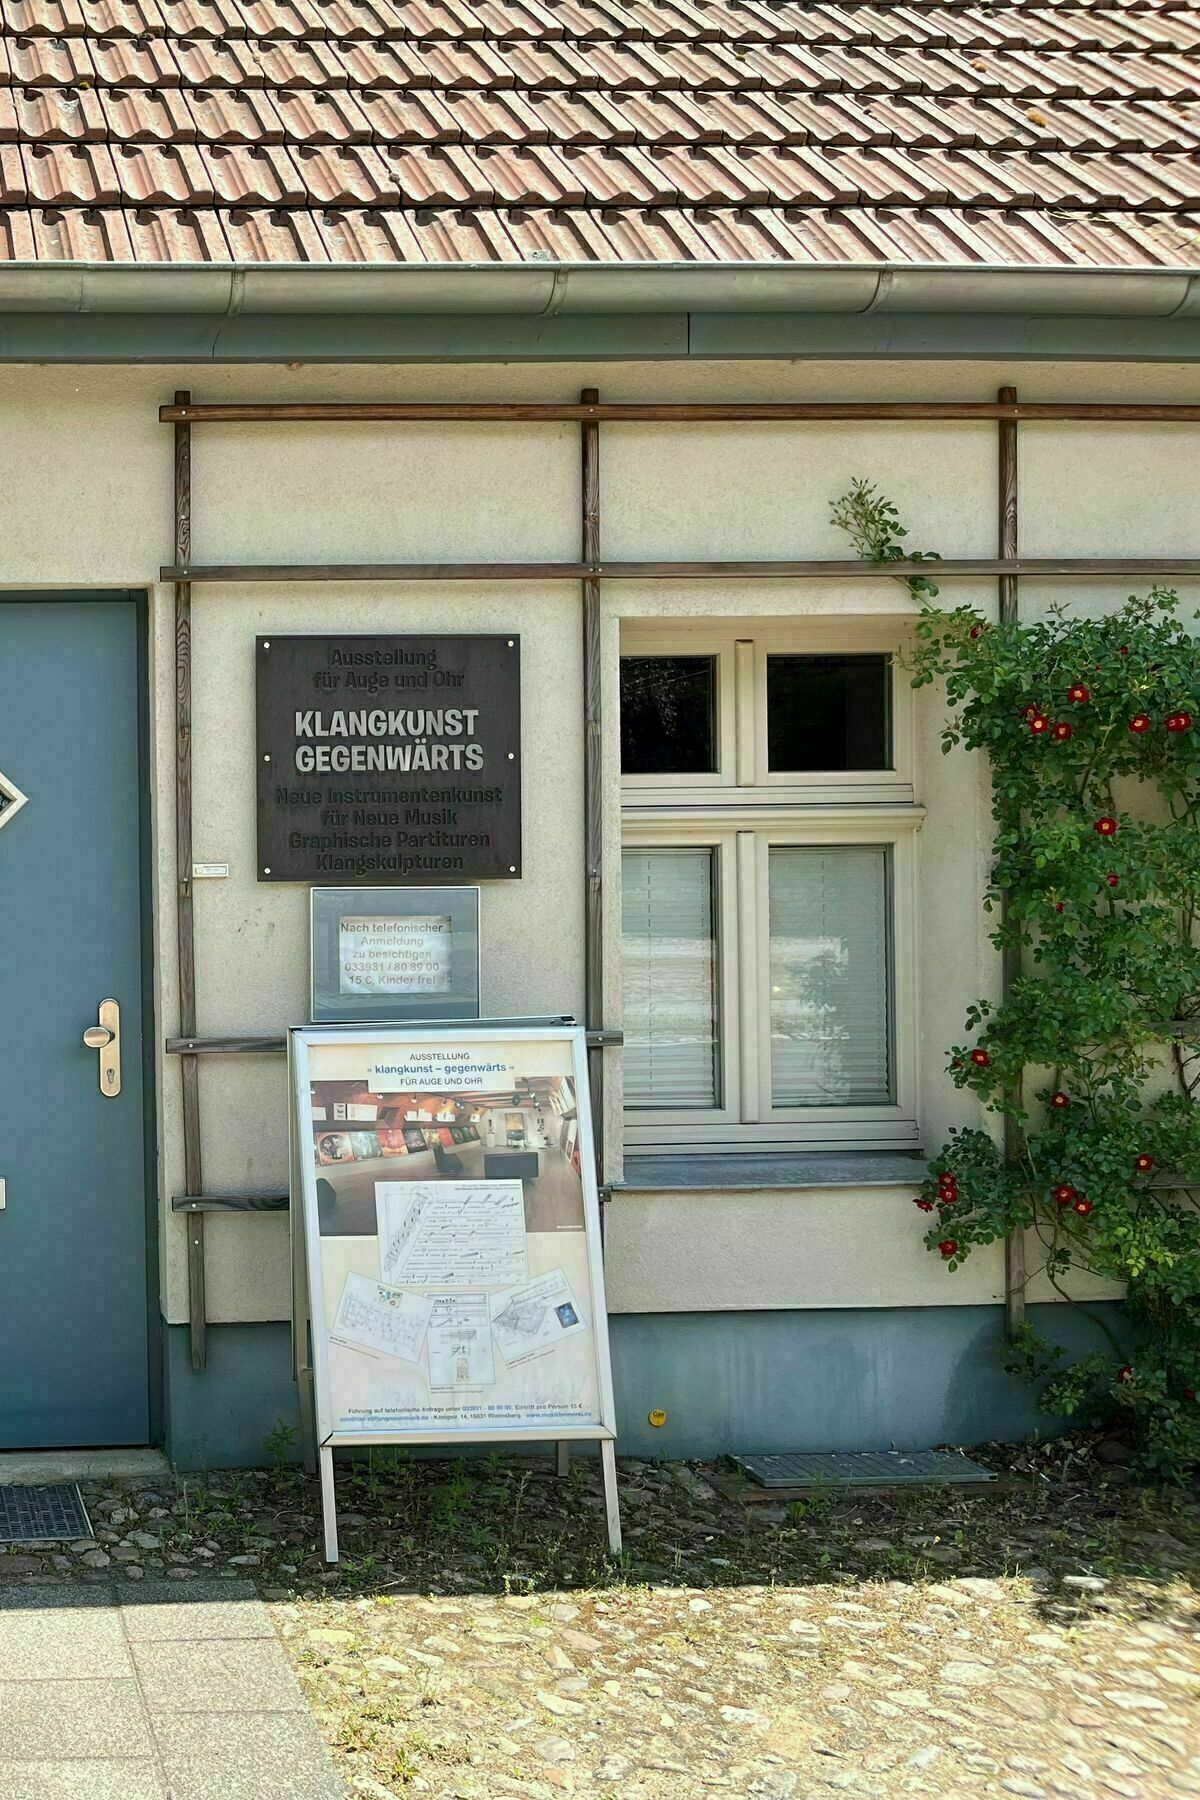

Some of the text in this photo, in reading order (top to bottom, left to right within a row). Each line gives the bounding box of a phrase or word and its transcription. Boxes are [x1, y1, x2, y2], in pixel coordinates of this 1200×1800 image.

[331, 649, 437, 670] Ausstellung
[314, 671, 465, 692] für Auge und Ohr
[295, 709, 479, 737] KLANGKUNST
[295, 738, 484, 772] GEGENWÄRTS
[277, 787, 503, 805] Neue Instrumentenkunst
[322, 809, 458, 826] für Neue Musik
[290, 831, 490, 852] Graphische Partituren
[317, 855, 464, 876] Klangskulpturen
[341, 922, 443, 933] Nach telefonischer
[361, 936, 424, 947] Anmeldung
[353, 950, 432, 961] zu besichtigen
[345, 963, 385, 972] 033931
[425, 963, 439, 972] 00
[349, 976, 362, 985] 15
[378, 976, 414, 985] Kinder
[417, 975, 436, 985] frei
[409, 1053, 470, 1061] AUSSTELLUNG
[375, 1065, 433, 1075] klangkunst
[444, 1063, 507, 1074] gegenwärts
[400, 1077, 417, 1086] FÜR
[419, 1077, 442, 1085] AUGE
[444, 1077, 463, 1085] UND
